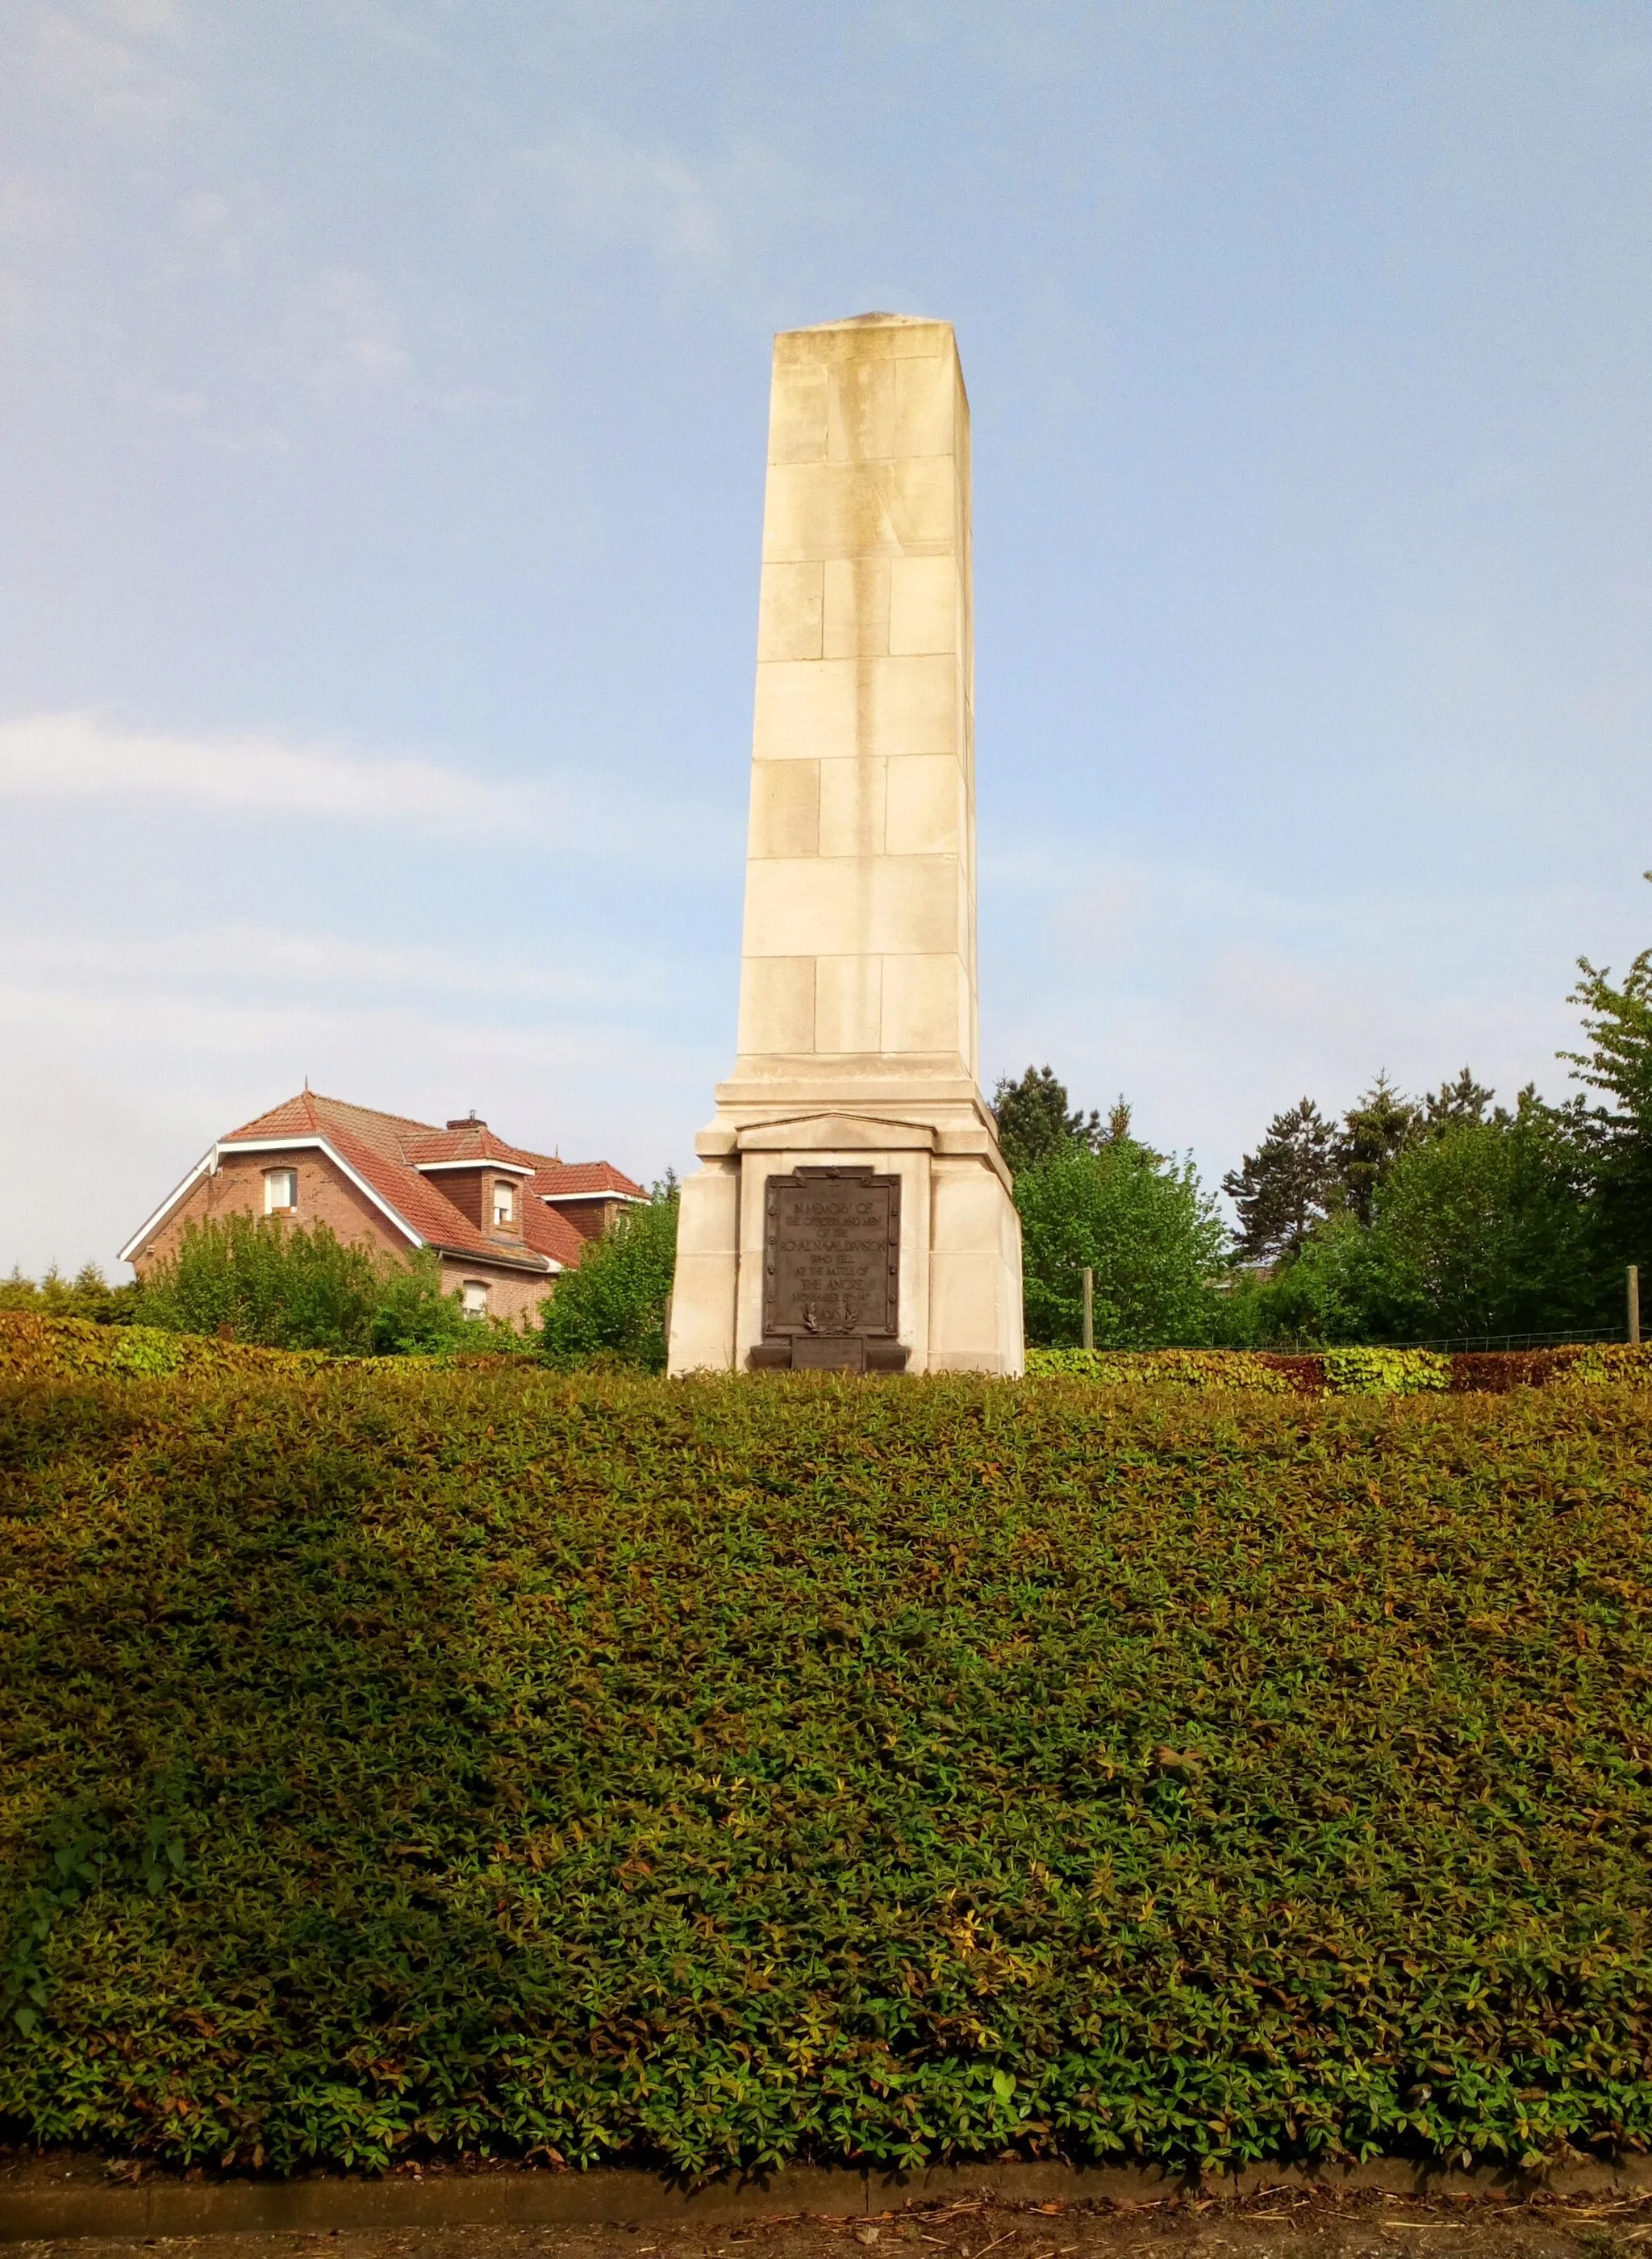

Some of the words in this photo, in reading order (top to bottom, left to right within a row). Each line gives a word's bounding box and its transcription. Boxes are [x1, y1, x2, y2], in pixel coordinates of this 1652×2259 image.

[806, 1202, 851, 1213] MEMORY
[856, 1202, 874, 1214] OF
[843, 1217, 859, 1226] AND
[862, 1217, 881, 1226] MEN
[817, 1230, 828, 1238] OF
[781, 1240, 811, 1251] ROYAL
[813, 1240, 844, 1251] NAVAL
[845, 1240, 886, 1251] DIVISION
[809, 1255, 833, 1263] WHO
[836, 1255, 855, 1263] FELL
[809, 1267, 824, 1276] THE
[856, 1267, 869, 1276] OF
[801, 1279, 822, 1290] THE
